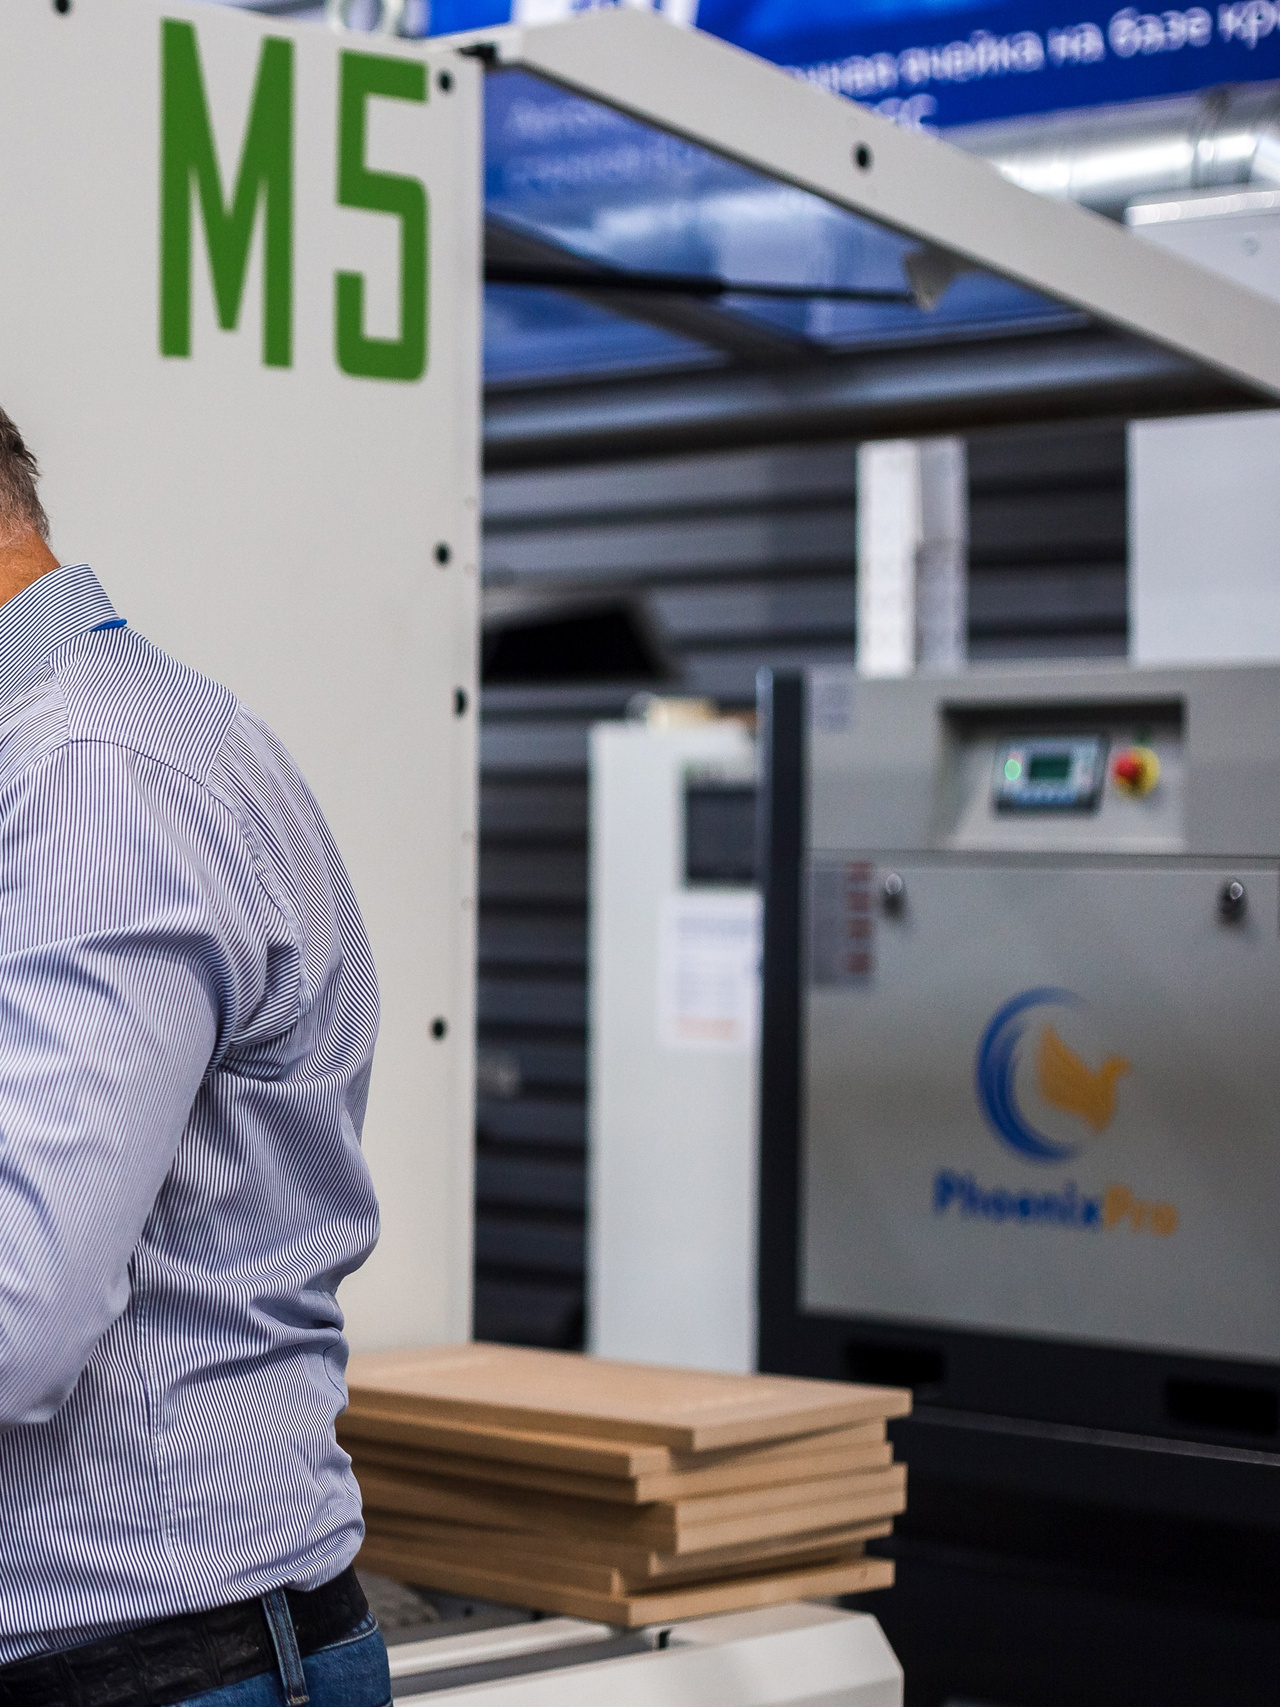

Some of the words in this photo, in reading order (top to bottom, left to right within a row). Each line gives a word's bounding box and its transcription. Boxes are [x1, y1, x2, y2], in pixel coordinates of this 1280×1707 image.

[899, 29, 1046, 89] ячейка
[1046, 21, 1106, 68] на
[1108, 6, 1214, 59] базе
[1217, 0, 1280, 51] кр
[160, 16, 429, 384] M5
[933, 1169, 1177, 1236] PhoenixPro
